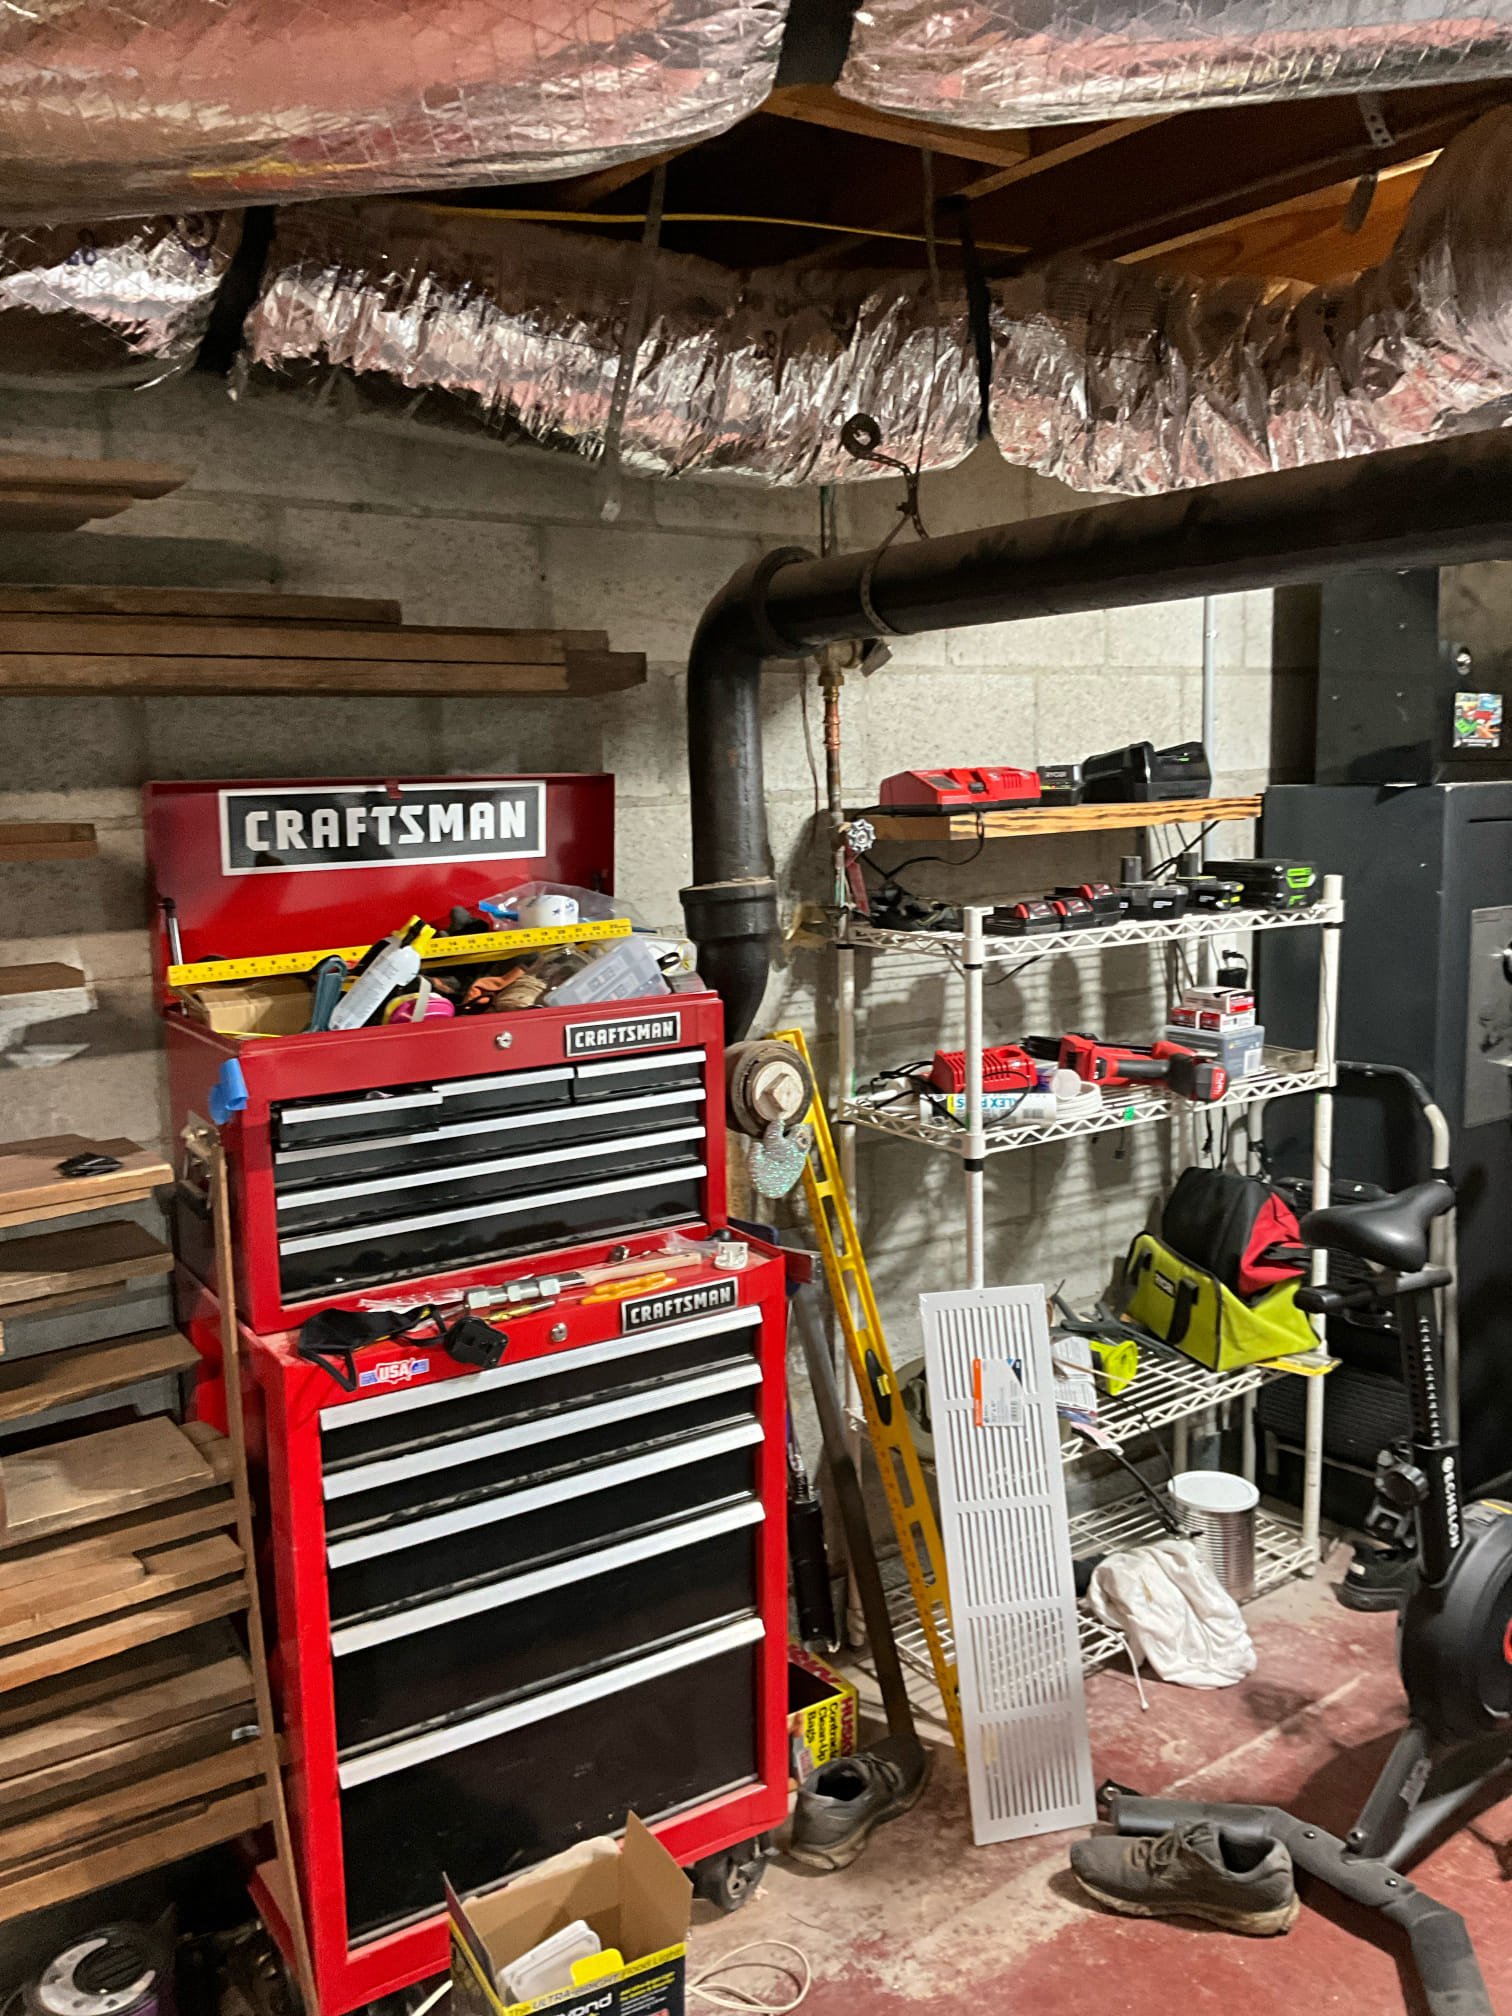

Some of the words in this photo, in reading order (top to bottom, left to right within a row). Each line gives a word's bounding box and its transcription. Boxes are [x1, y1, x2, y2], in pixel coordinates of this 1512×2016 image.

[245, 800, 526, 852] CRAFTSMAN
[574, 1020, 674, 1048] CRAFTSMAN
[630, 1286, 731, 1324] CRAFTSMAN
[379, 1362, 409, 1380] USA
[1444, 1472, 1460, 1549] ECHELON
[806, 1711, 817, 1744] Bags
